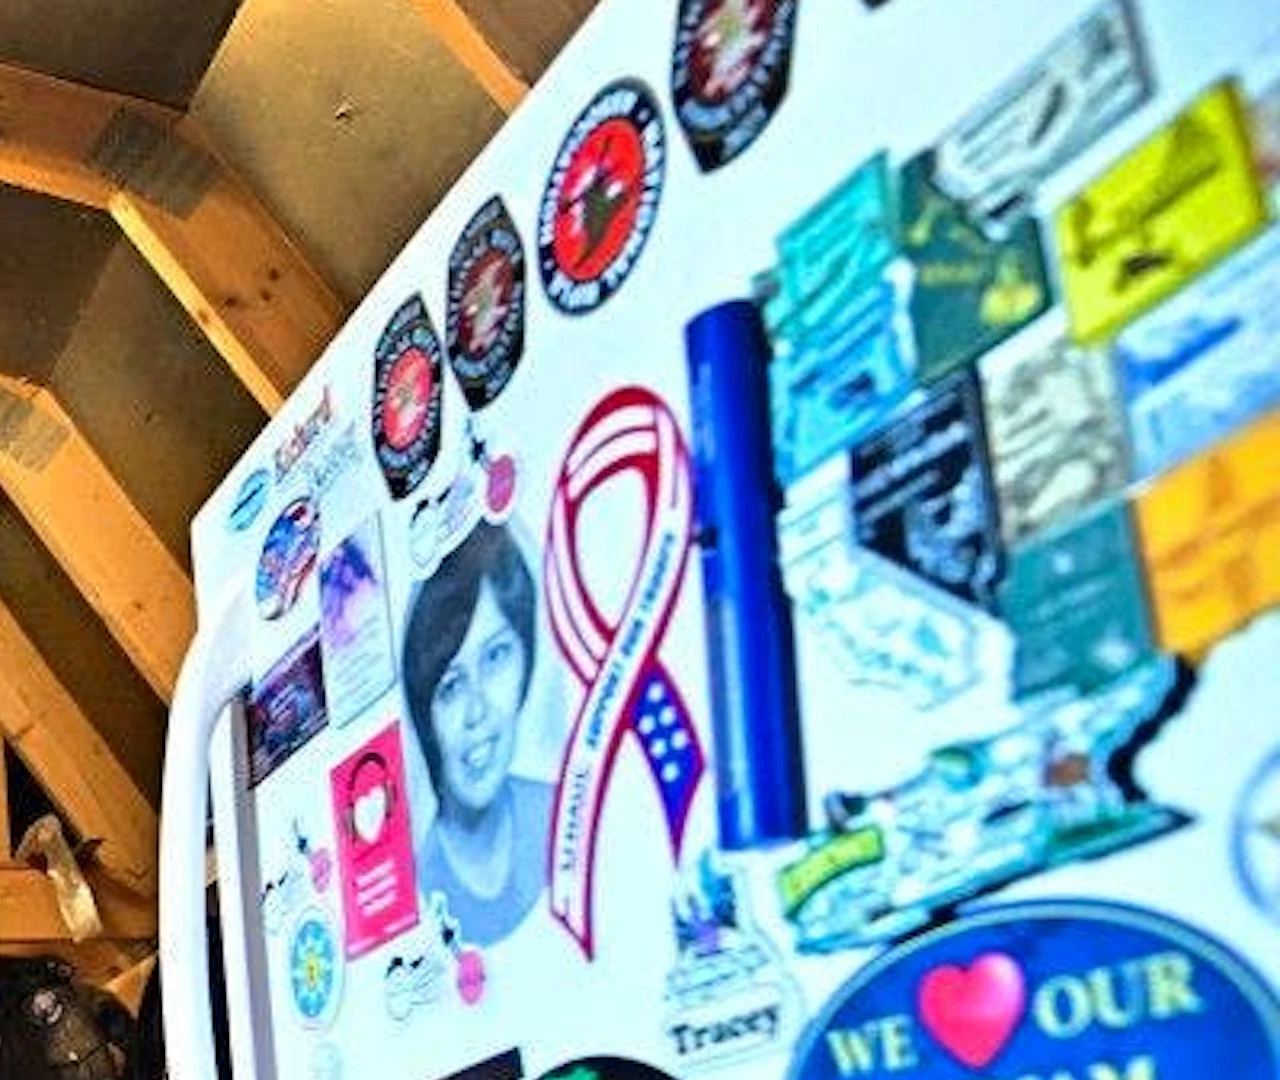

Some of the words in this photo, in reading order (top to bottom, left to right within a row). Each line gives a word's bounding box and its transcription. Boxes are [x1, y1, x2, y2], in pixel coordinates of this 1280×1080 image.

[671, 1002, 781, 1056] Tracey
[828, 1013, 919, 1078] WE
[1032, 951, 1202, 1038] OUR
